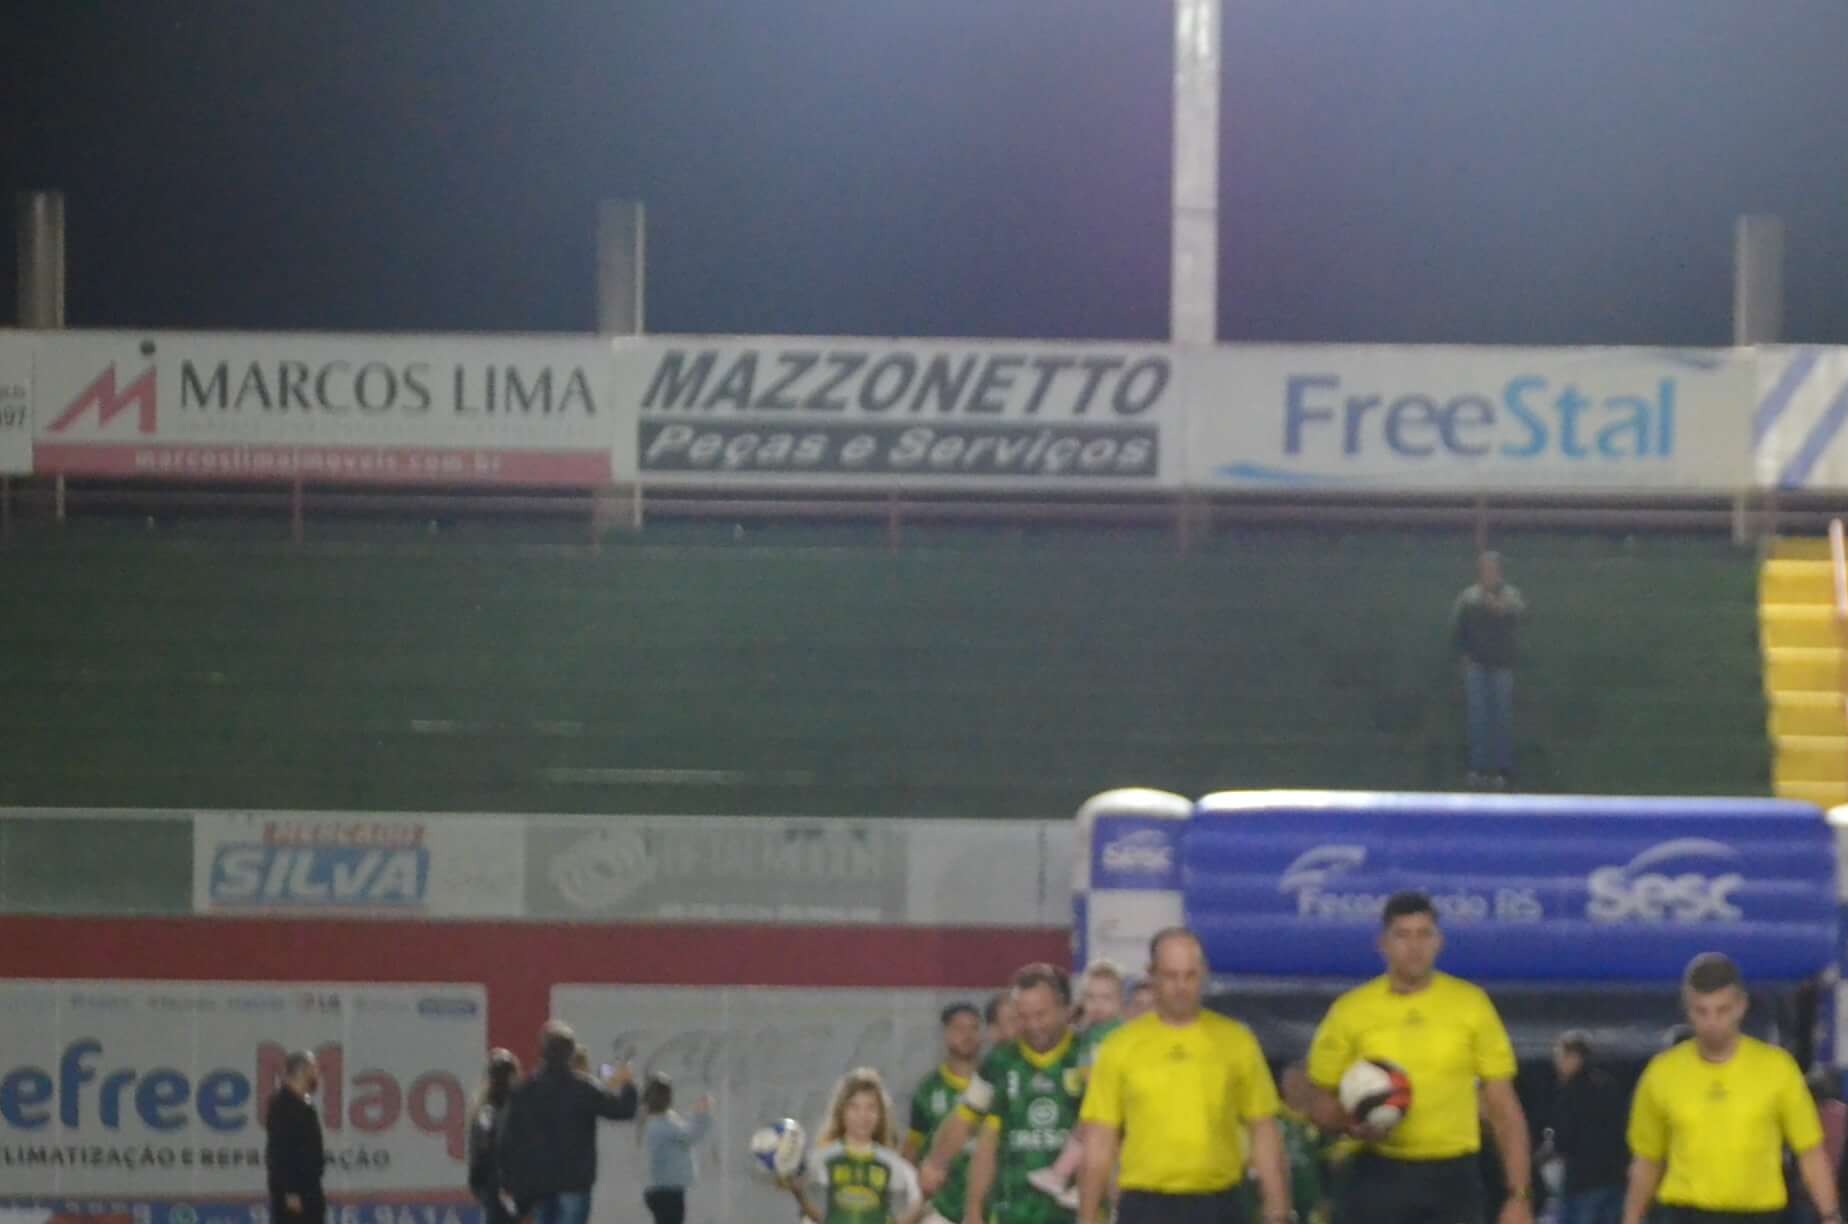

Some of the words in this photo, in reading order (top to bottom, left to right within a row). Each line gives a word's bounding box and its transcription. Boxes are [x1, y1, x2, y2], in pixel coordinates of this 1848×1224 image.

[180, 360, 430, 413] MARCOS
[454, 363, 596, 415] LIMA
[643, 350, 1172, 416] MAZZONETTO
[1283, 374, 1676, 460] FreeStal
[646, 425, 828, 467] Peças
[839, 432, 875, 465] e
[889, 427, 1153, 470] Serviços
[213, 848, 420, 899] SILVA
[0, 1145, 182, 1169] LIMATIZAÇÃO
[182, 1149, 193, 1165] E
